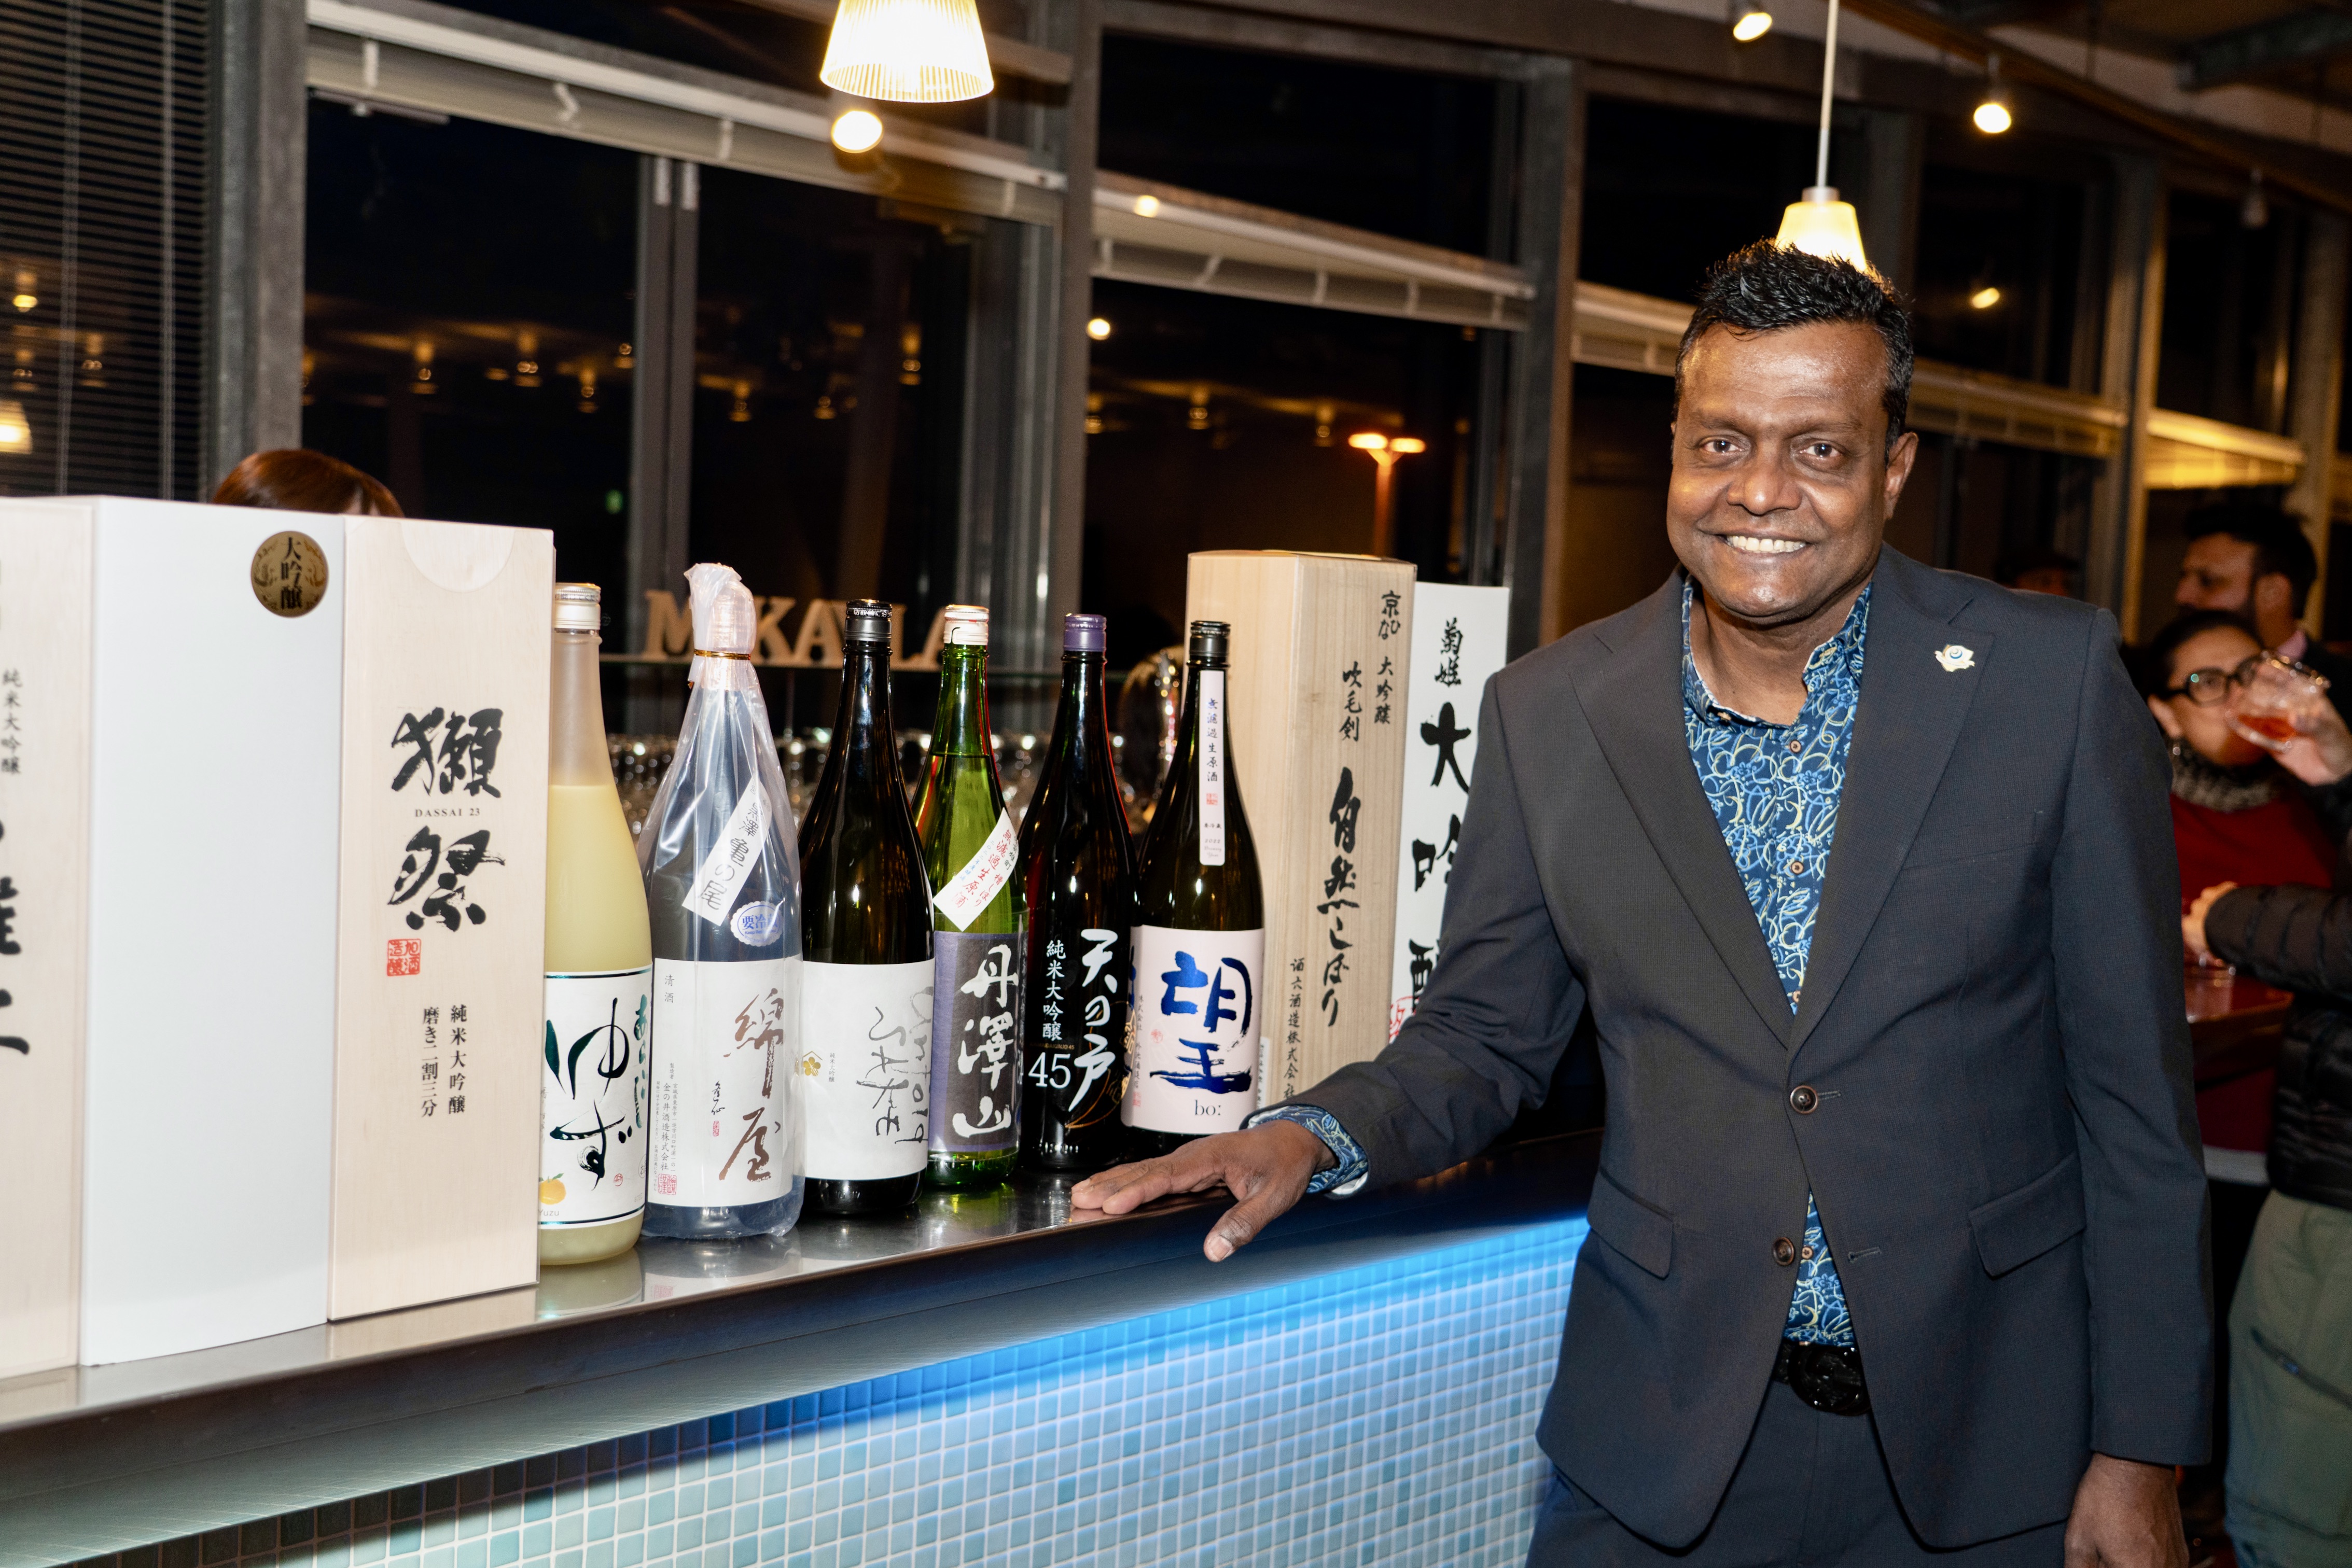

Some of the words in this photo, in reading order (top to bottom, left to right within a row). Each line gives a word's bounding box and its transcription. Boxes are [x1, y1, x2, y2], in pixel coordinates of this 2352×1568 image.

[282, 537, 302, 609] 大吟醸
[1435, 617, 1463, 688] 菊姫
[1206, 698, 1218, 782] 無濾過生原酒
[415, 808, 463, 818] DASSAI
[469, 808, 480, 817] 23
[665, 974, 675, 1003] 清酒
[1042, 940, 1066, 1041] 純米大吟醸
[1068, 928, 1118, 1112] 天の戸
[1149, 950, 1252, 1095] 望
[1284, 957, 1305, 1099] 酒六酒造株式会社
[421, 1006, 440, 1118] 磨き二割三分
[449, 1004, 467, 1115] 純米大吟醸
[1028, 1052, 1071, 1089] 45
[660, 1082, 672, 1171] 金の井酒造株式会社
